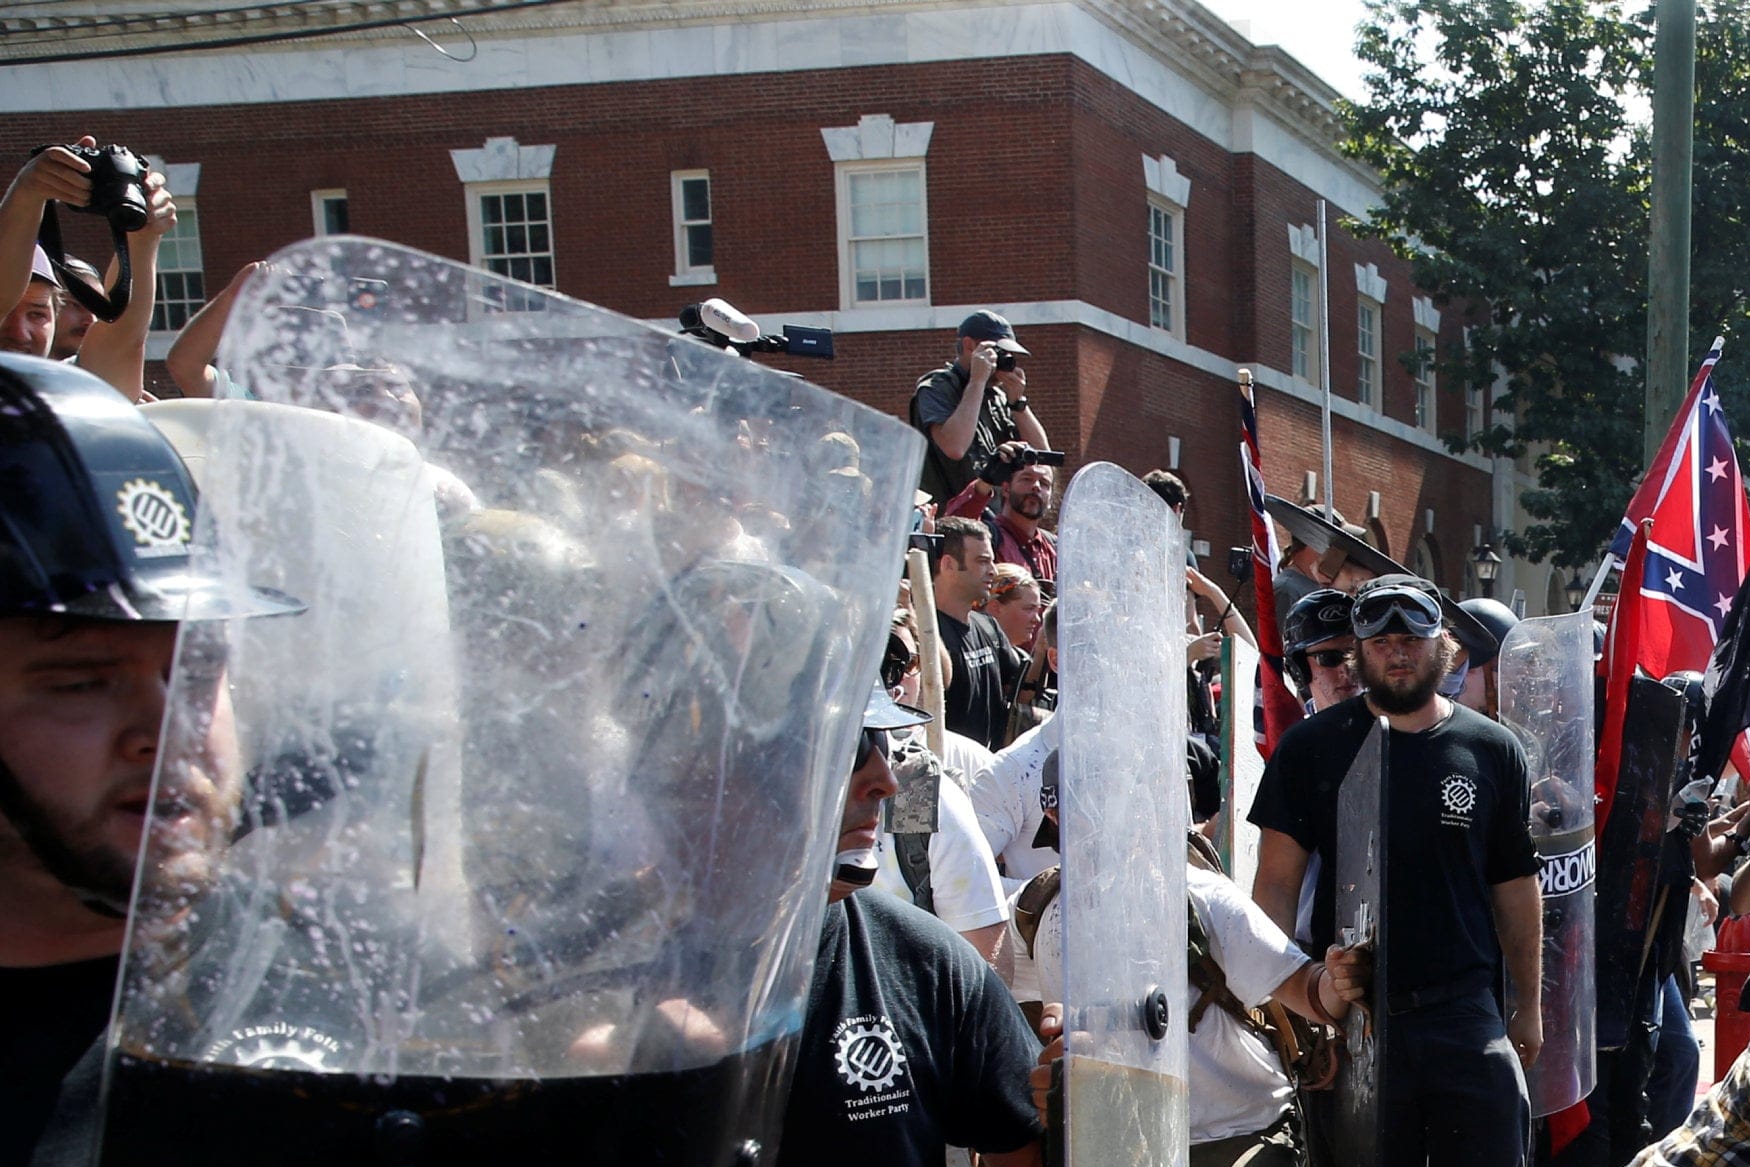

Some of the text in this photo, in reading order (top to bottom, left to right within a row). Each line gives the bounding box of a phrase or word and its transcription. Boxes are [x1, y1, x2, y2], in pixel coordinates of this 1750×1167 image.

[846, 1014, 878, 1026] Family
[232, 1022, 298, 1040] Family
[303, 1027, 339, 1053] Folk
[845, 1089, 910, 1108] Traditionalist
[848, 1103, 909, 1121] Worker Party
